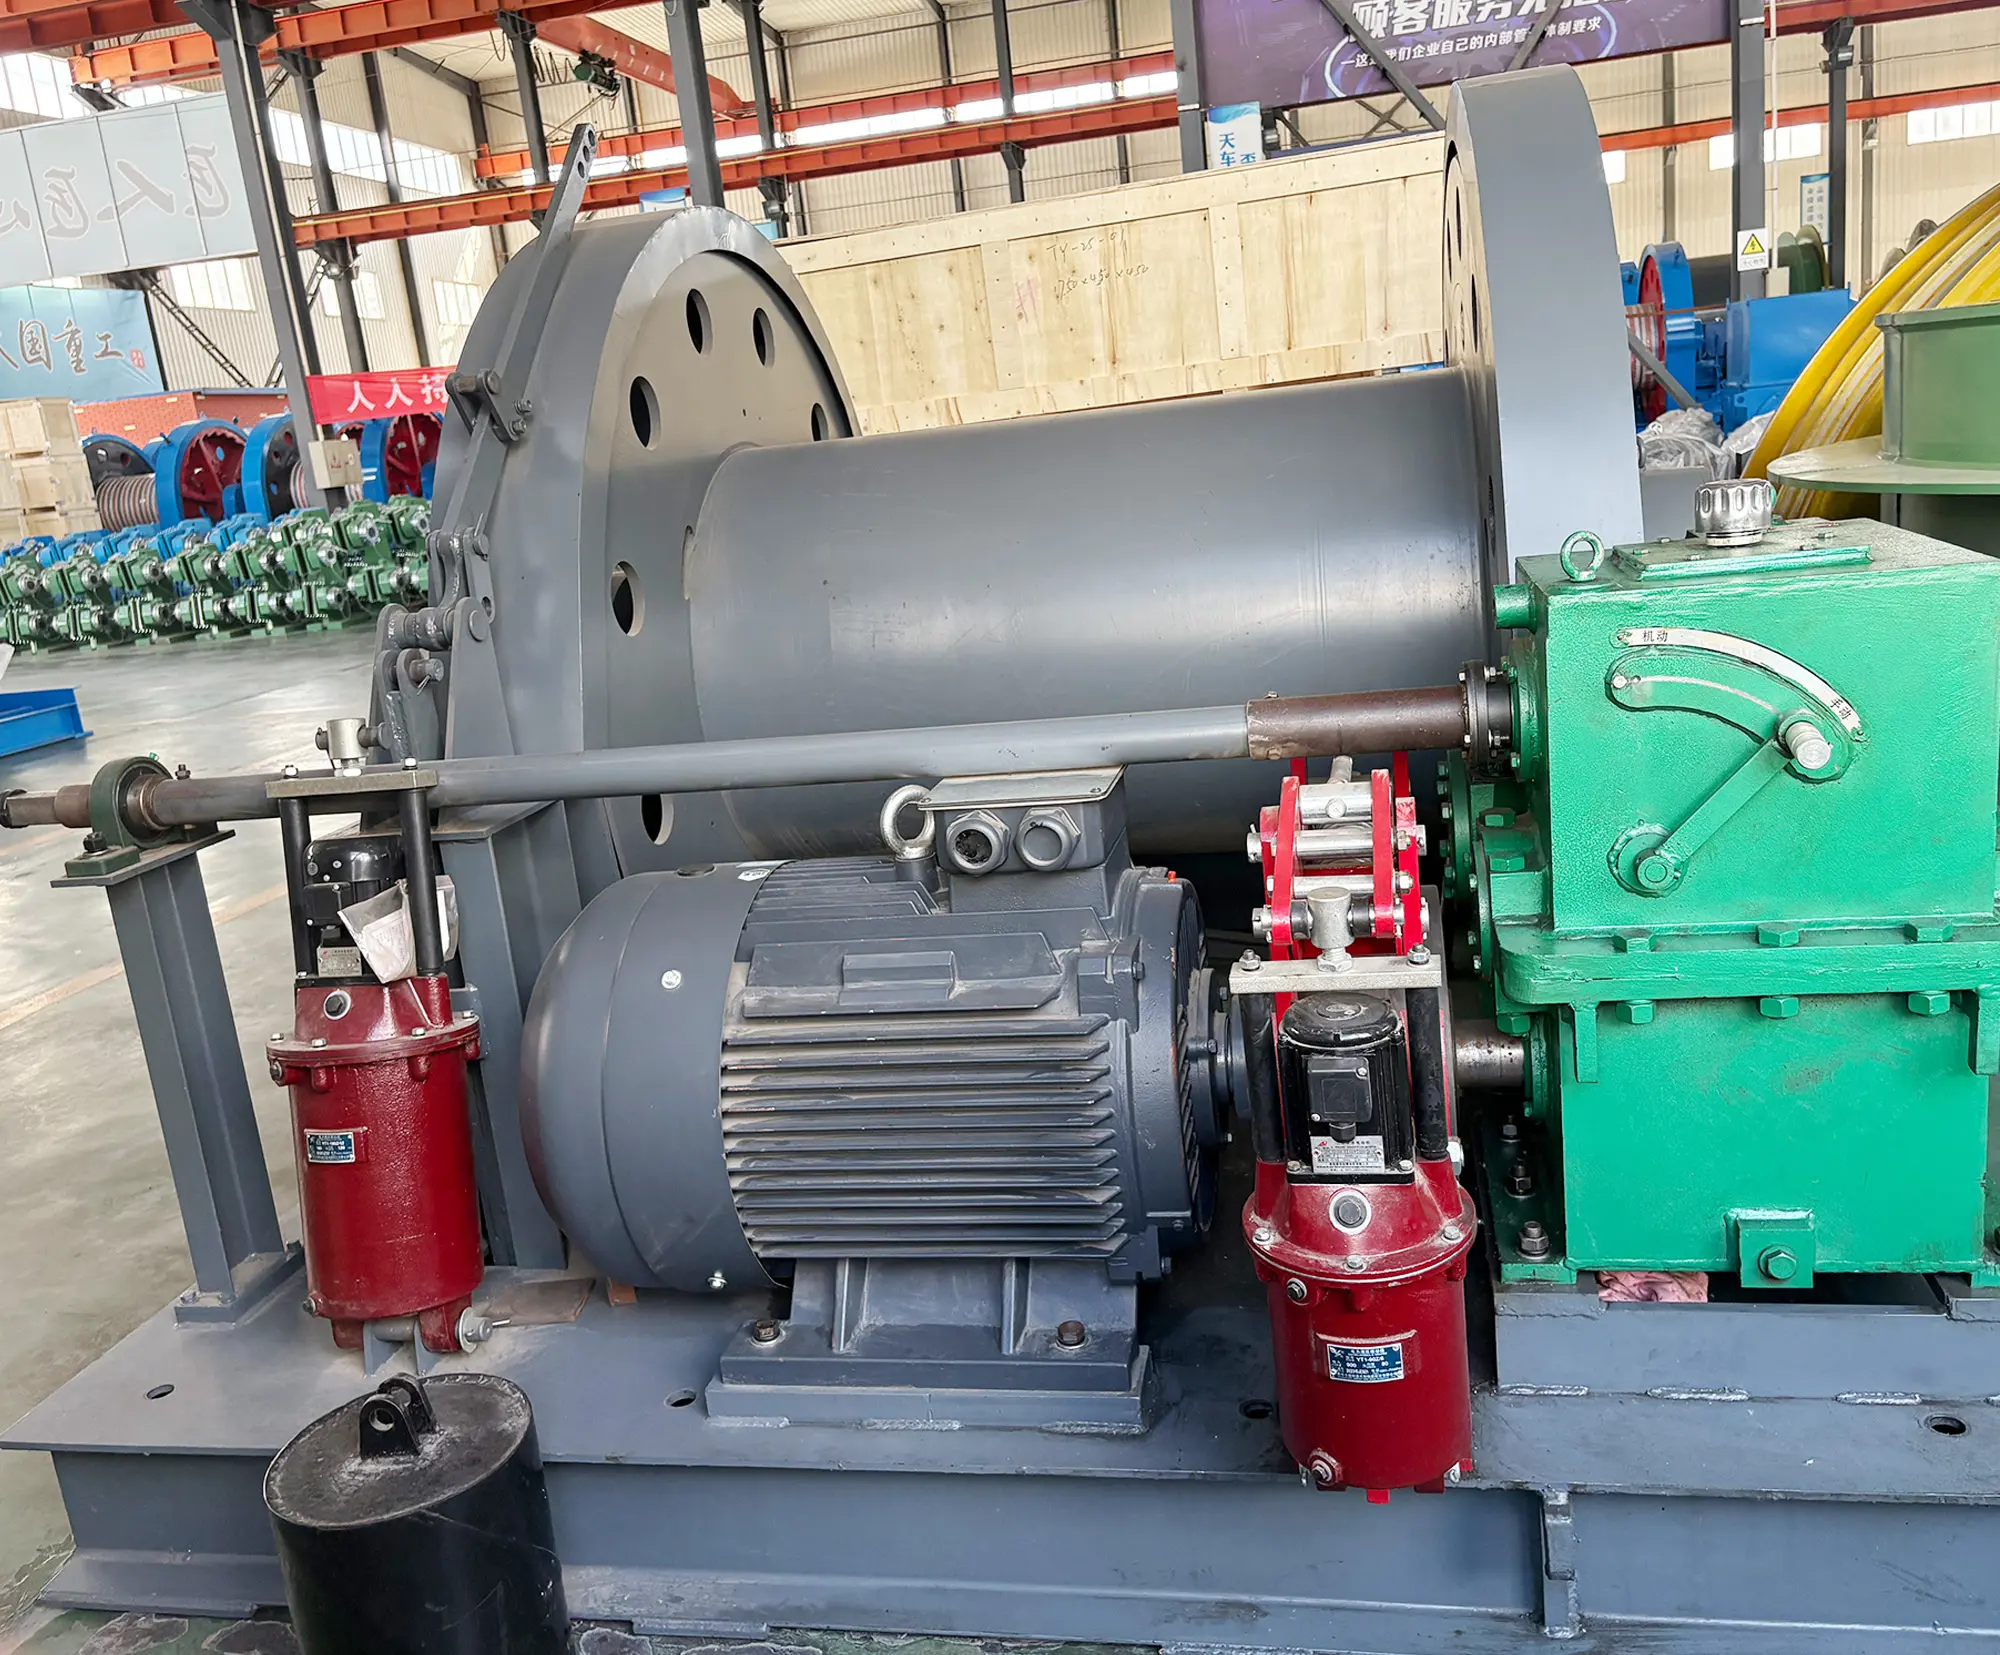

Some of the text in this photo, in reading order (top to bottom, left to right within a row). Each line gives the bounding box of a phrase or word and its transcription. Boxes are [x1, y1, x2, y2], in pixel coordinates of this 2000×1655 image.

[0, 319, 125, 375] 国重工
[1643, 630, 1668, 643] 机动
[1830, 697, 1851, 720] 手动
